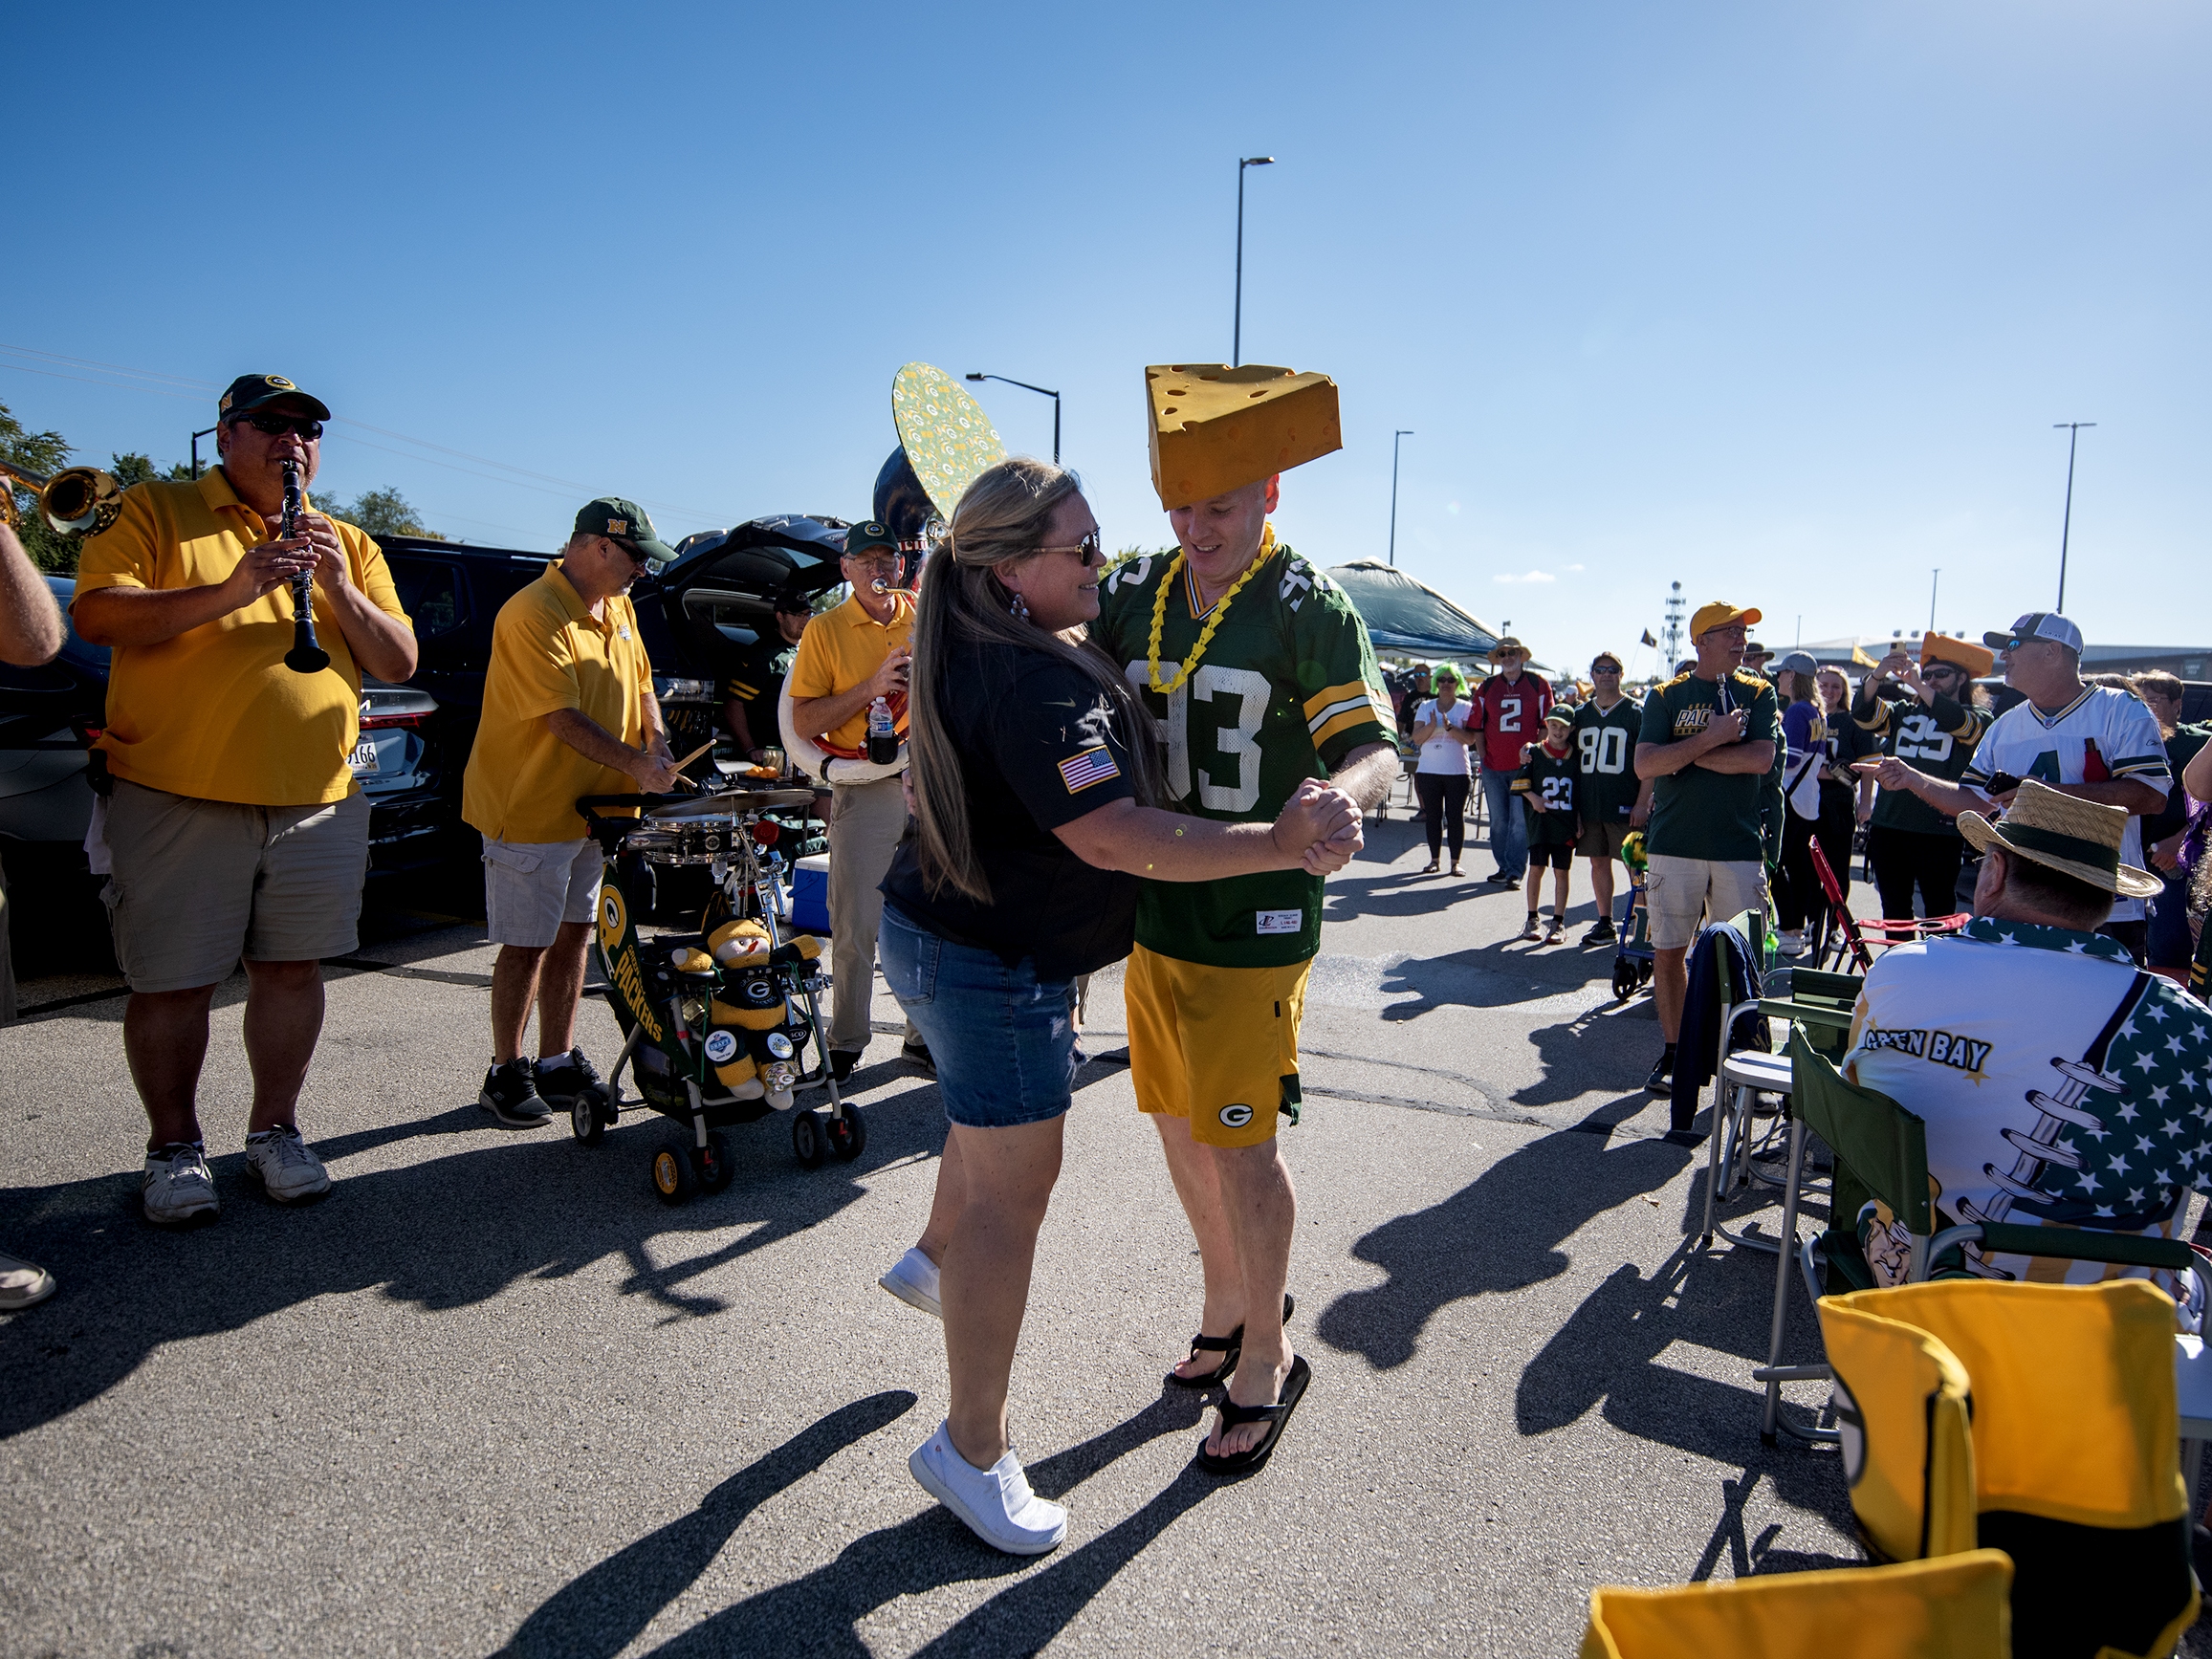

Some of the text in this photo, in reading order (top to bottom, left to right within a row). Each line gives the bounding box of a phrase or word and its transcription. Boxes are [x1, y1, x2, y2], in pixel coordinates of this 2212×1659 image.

[607, 518, 627, 535] N
[1500, 699, 1522, 732] 2
[1675, 709, 1751, 727] PACS
[1125, 659, 1272, 813] 93
[1579, 727, 1628, 775] 80
[1894, 714, 1953, 761] 25
[1543, 776, 1573, 811] 23
[613, 950, 663, 1042] PACKERS
[747, 981, 771, 998] G
[1928, 1030, 1992, 1073] BAY
[1218, 1103, 1254, 1127] G
